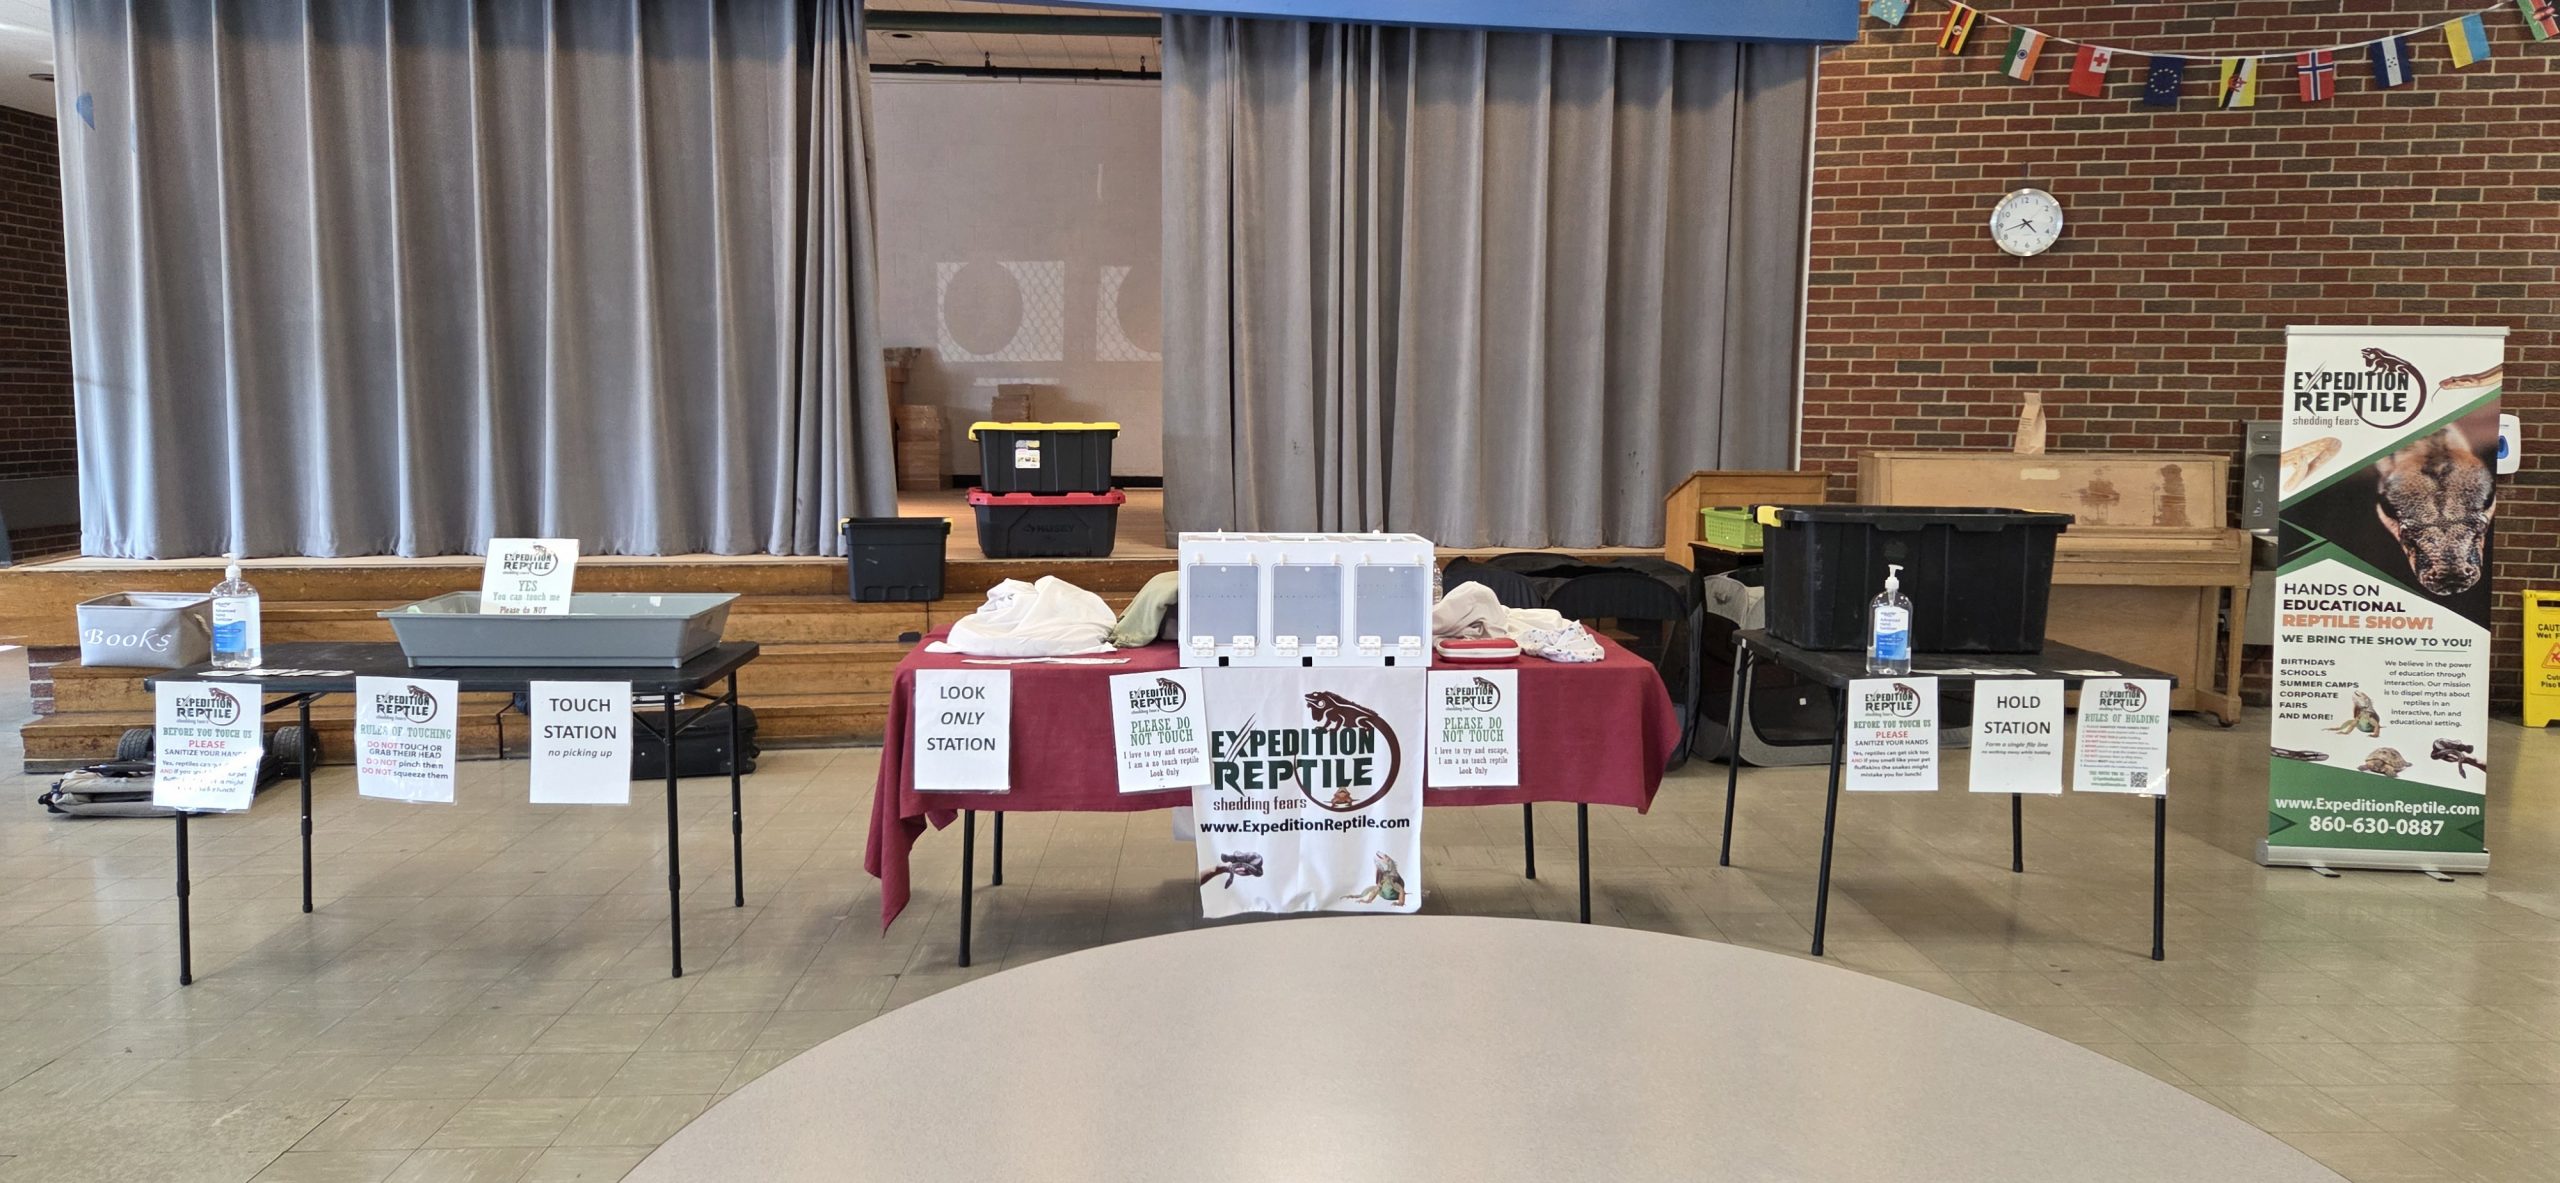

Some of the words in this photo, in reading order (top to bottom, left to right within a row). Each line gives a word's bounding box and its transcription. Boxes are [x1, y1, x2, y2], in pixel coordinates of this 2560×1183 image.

[2294, 371, 2409, 390] EXPEDITION
[2294, 392, 2407, 416] REPTILE
[2292, 417, 2333, 428] shedding
[2335, 417, 2359, 426] fears
[504, 562, 550, 570] REPTILE
[519, 580, 538, 592] YES
[2284, 583, 2348, 596] HANDS
[2353, 584, 2380, 596] ON
[2283, 600, 2406, 612] EDUCATIONAL
[2282, 614, 2360, 628] REPTILE
[2366, 616, 2434, 630] SHOW!
[84, 628, 172, 653] Books
[2282, 634, 2303, 643] WE
[2307, 635, 2346, 644] BRING
[2350, 636, 2374, 644] THE
[2378, 636, 2417, 646] SHOW
[2421, 638, 2438, 646] TO
[2442, 638, 2472, 647] YOU!
[940, 686, 985, 700] LOOK
[1129, 687, 1178, 699] EXPEDITION
[1445, 686, 1493, 696] EXPEDITION
[1865, 693, 1913, 702] EXPEDITION
[176, 697, 232, 708] EXPEDITION
[376, 694, 429, 705] EXPEDITION
[549, 698, 611, 712] TOUCH
[1130, 696, 1179, 709] REPTILE
[1446, 696, 1493, 705] REPTILE
[1997, 696, 2040, 709] HOLD
[177, 708, 232, 719] REPTILE
[377, 704, 428, 716] REPTILE
[1865, 702, 1912, 712] REPTILE
[941, 712, 985, 725] ONLY
[1131, 718, 1171, 733] PLEASE
[1177, 716, 1190, 729] DO
[1444, 717, 1483, 729] PLEASE
[1489, 717, 1502, 729] DO
[1854, 721, 1880, 729] BEFORE
[2085, 714, 2108, 722] RULES
[2113, 714, 2122, 722] OF
[2126, 715, 2160, 724] HOLDING
[163, 727, 194, 736] BEFORE
[196, 728, 212, 737] YOU
[215, 729, 240, 738] TOUCH
[243, 730, 252, 738] US
[360, 724, 388, 735] RULES
[392, 727, 403, 736] OF
[407, 727, 451, 739] TOUCHING
[544, 725, 616, 739] STATION
[1984, 722, 2051, 734] STATION
[1130, 733, 1152, 746] NOT
[1158, 729, 1193, 744] TOUCH
[1442, 730, 1463, 742] NOT
[1469, 729, 1504, 742] TOUCH
[188, 740, 225, 748] PLEASE
[927, 737, 996, 751] STATION
[1211, 727, 1375, 758] EXPEDITION
[563, 748, 597, 758] picking
[600, 750, 612, 758] up
[427, 770, 448, 779] them
[1150, 770, 1163, 778] Look
[1166, 768, 1179, 776] Only
[1213, 758, 1374, 797] REPTILE
[1213, 797, 1270, 814] shedding
[1274, 796, 1307, 810] fears
[2275, 798, 2480, 816] www.ExpeditionReptile.com
[1200, 815, 1410, 835] www.ExpeditionReptile.com
[2309, 815, 2444, 836] 860-630-0887
